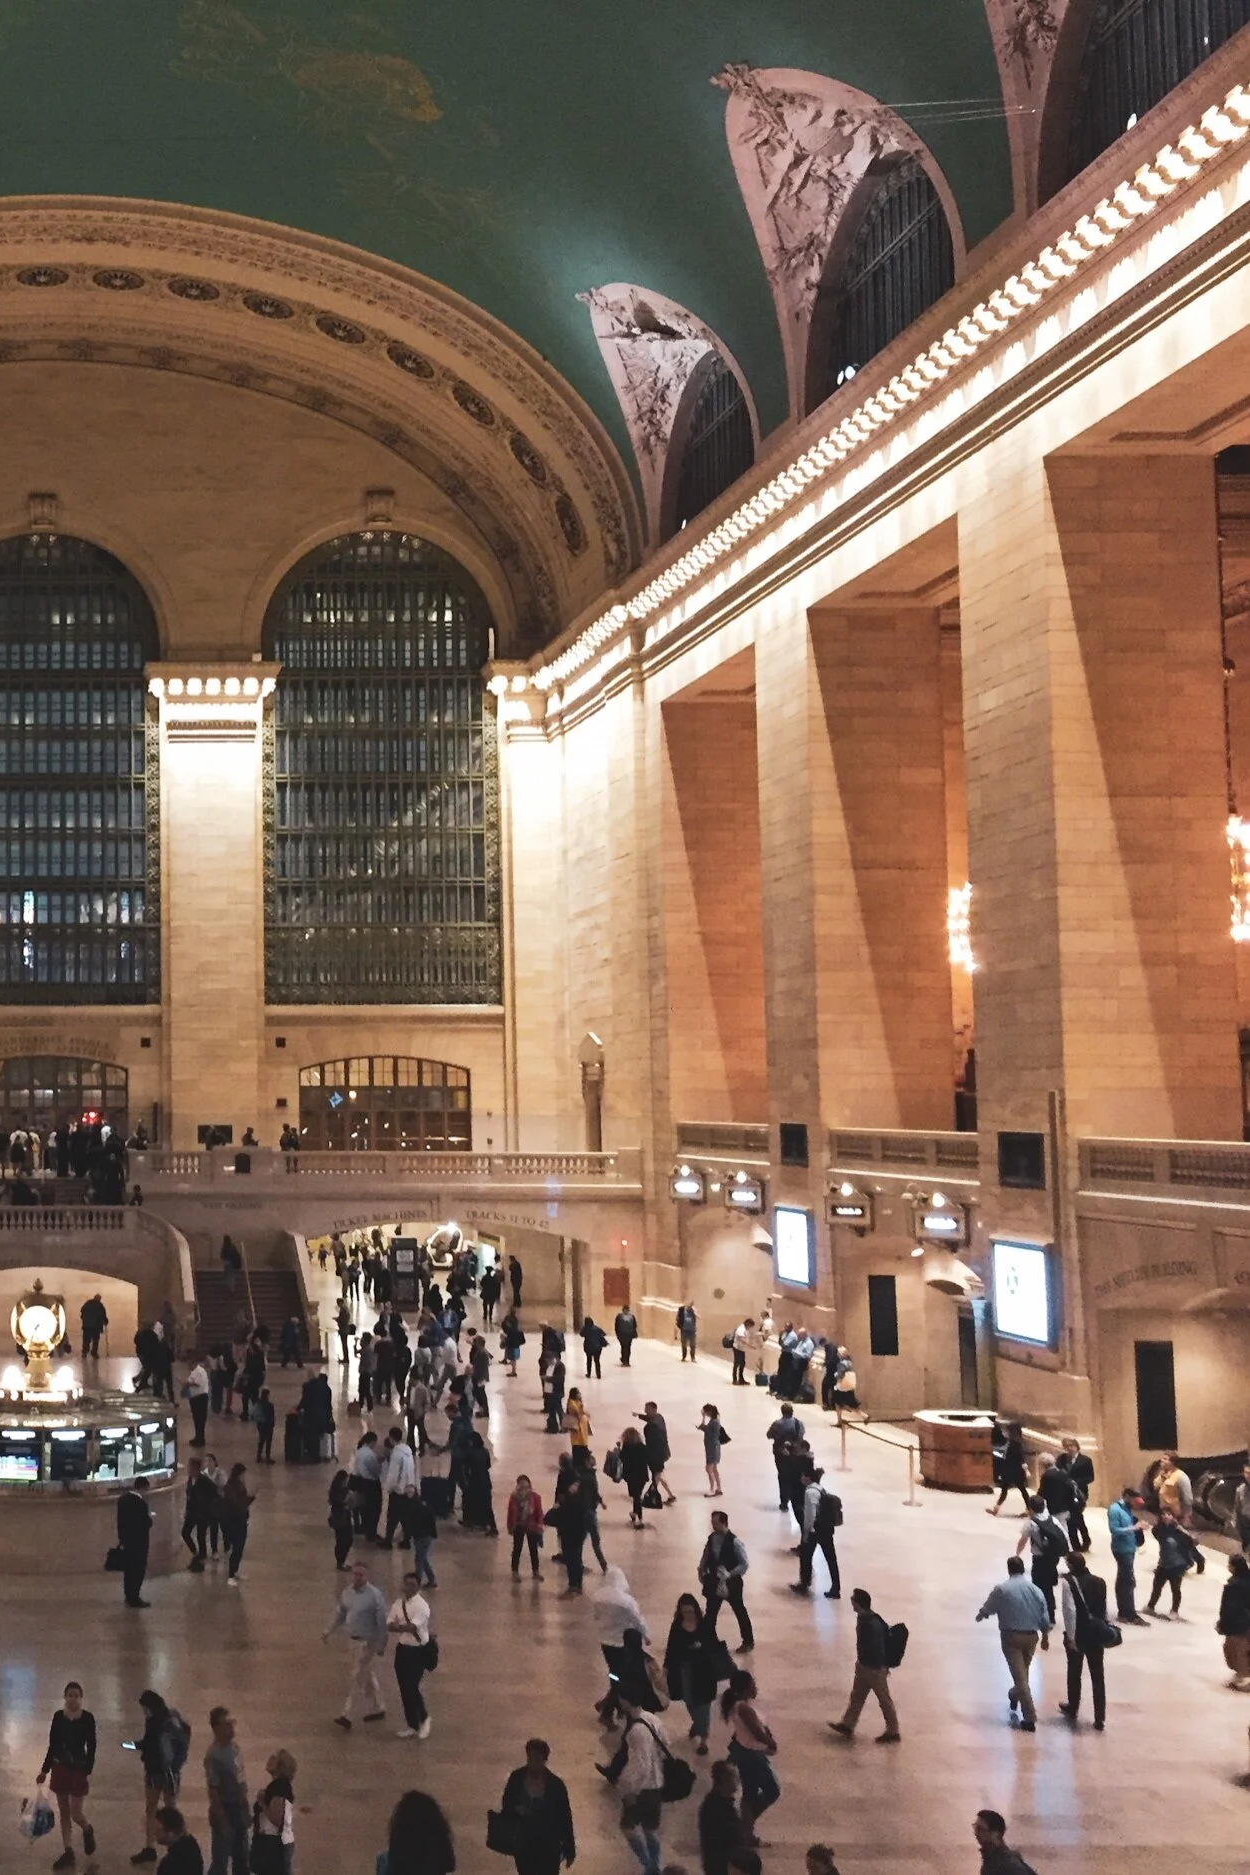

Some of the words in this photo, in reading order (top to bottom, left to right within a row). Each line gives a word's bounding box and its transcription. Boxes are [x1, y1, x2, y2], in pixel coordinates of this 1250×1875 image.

[332, 1213, 367, 1229] TICKET
[372, 1209, 427, 1222] MACHINES
[464, 1209, 506, 1221] TRACKS
